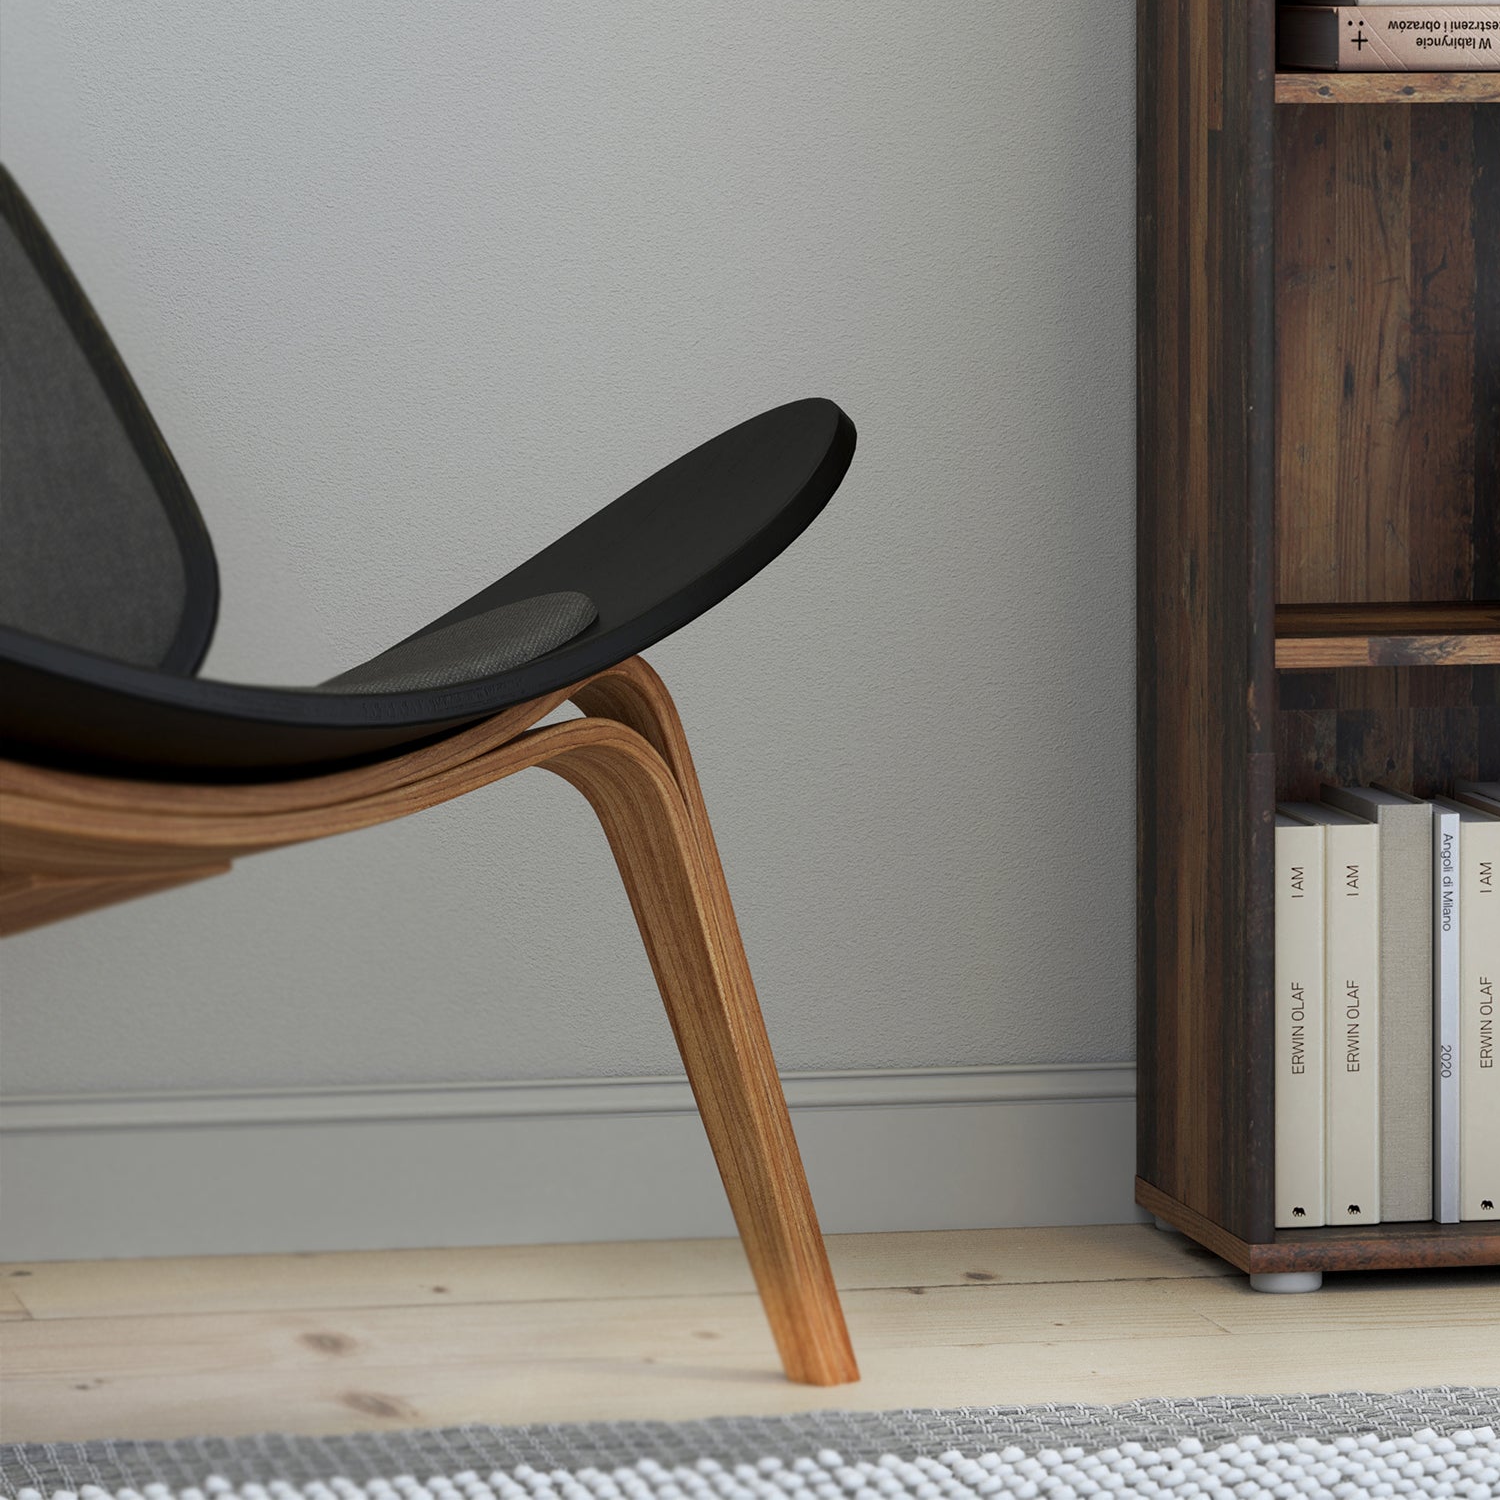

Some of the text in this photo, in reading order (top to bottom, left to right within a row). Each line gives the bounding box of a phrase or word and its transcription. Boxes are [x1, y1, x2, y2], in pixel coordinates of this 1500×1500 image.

[1388, 20, 1440, 33] obrazów
[1444, 21, 1447, 32] i
[1416, 35, 1492, 49] W labiryncie
[1291, 866, 1305, 891] AM
[1346, 865, 1360, 889] AM
[1440, 833, 1453, 932] Angoli di Milano
[1479, 861, 1492, 886] AM
[1291, 982, 1305, 1075] ERWIN OLAF
[1346, 980, 1360, 1072] ERWIN OLAF
[1480, 977, 1493, 1069] ERWIN OLAF
[1440, 1045, 1452, 1078] 2020
